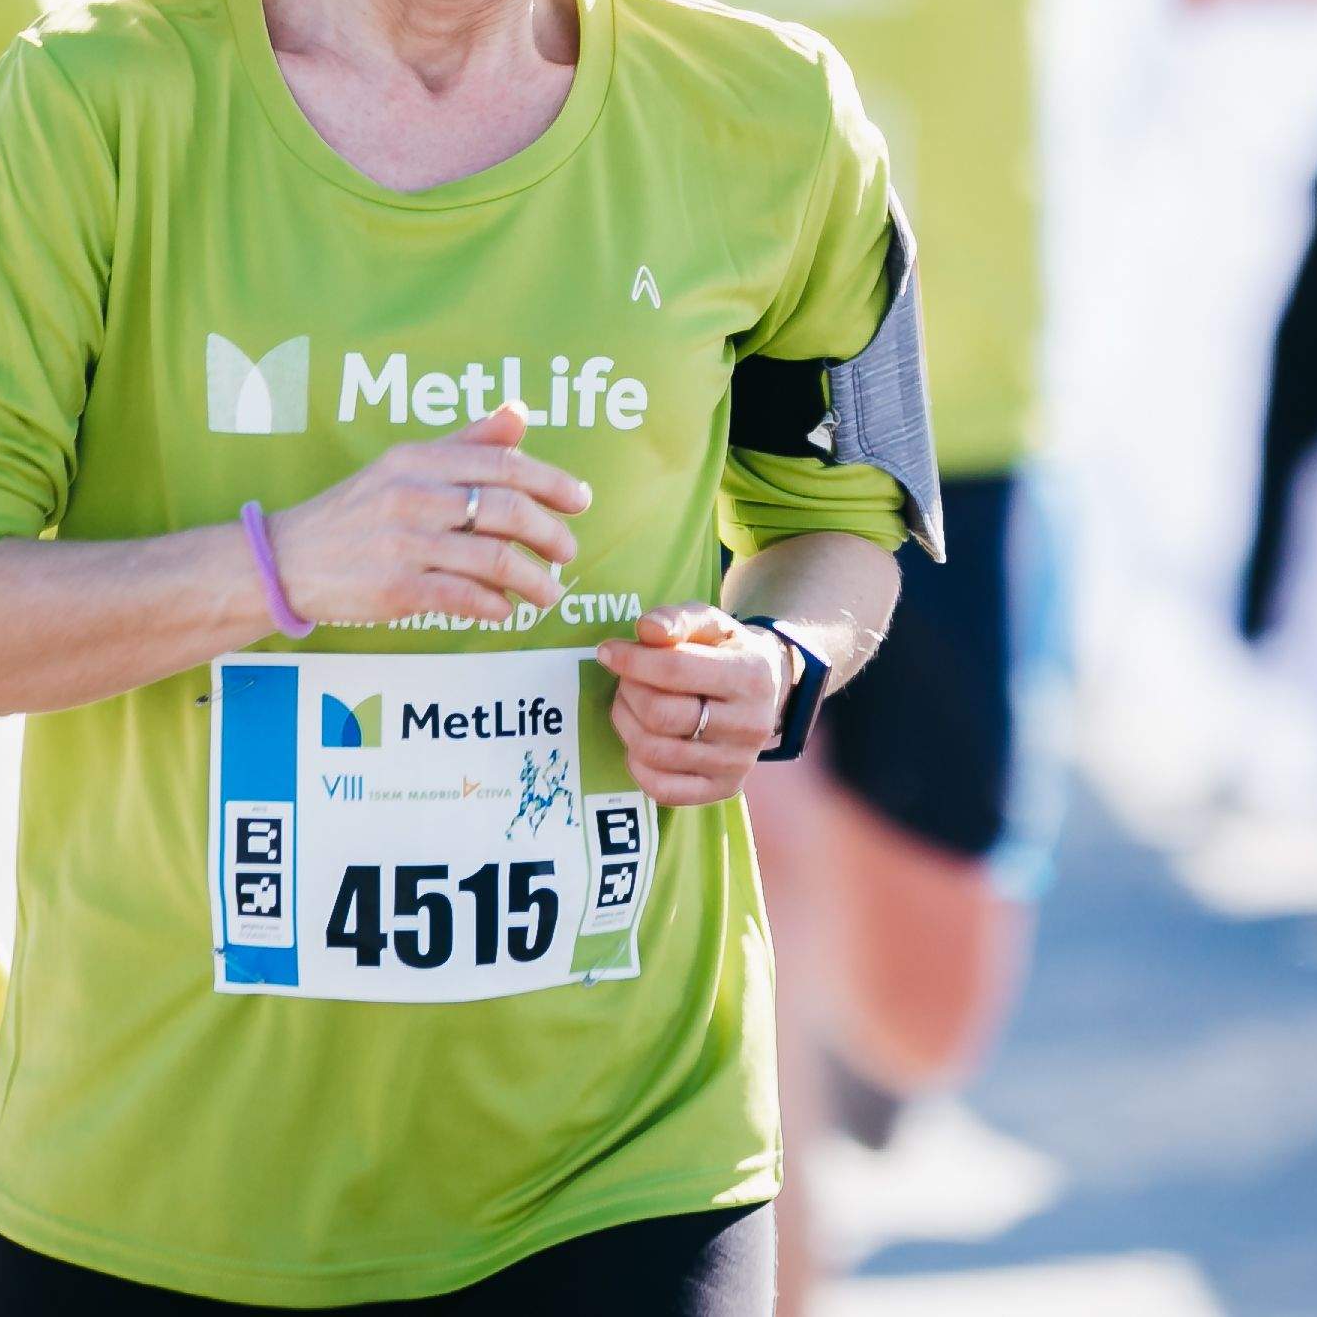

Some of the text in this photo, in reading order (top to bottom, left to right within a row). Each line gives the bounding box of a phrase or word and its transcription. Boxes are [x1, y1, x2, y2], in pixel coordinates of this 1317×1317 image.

[338, 353, 648, 429] MetLife
[401, 697, 564, 740] MetLife
[322, 774, 364, 802] VIII
[408, 789, 461, 801] MADRID
[326, 860, 559, 970] 4515
